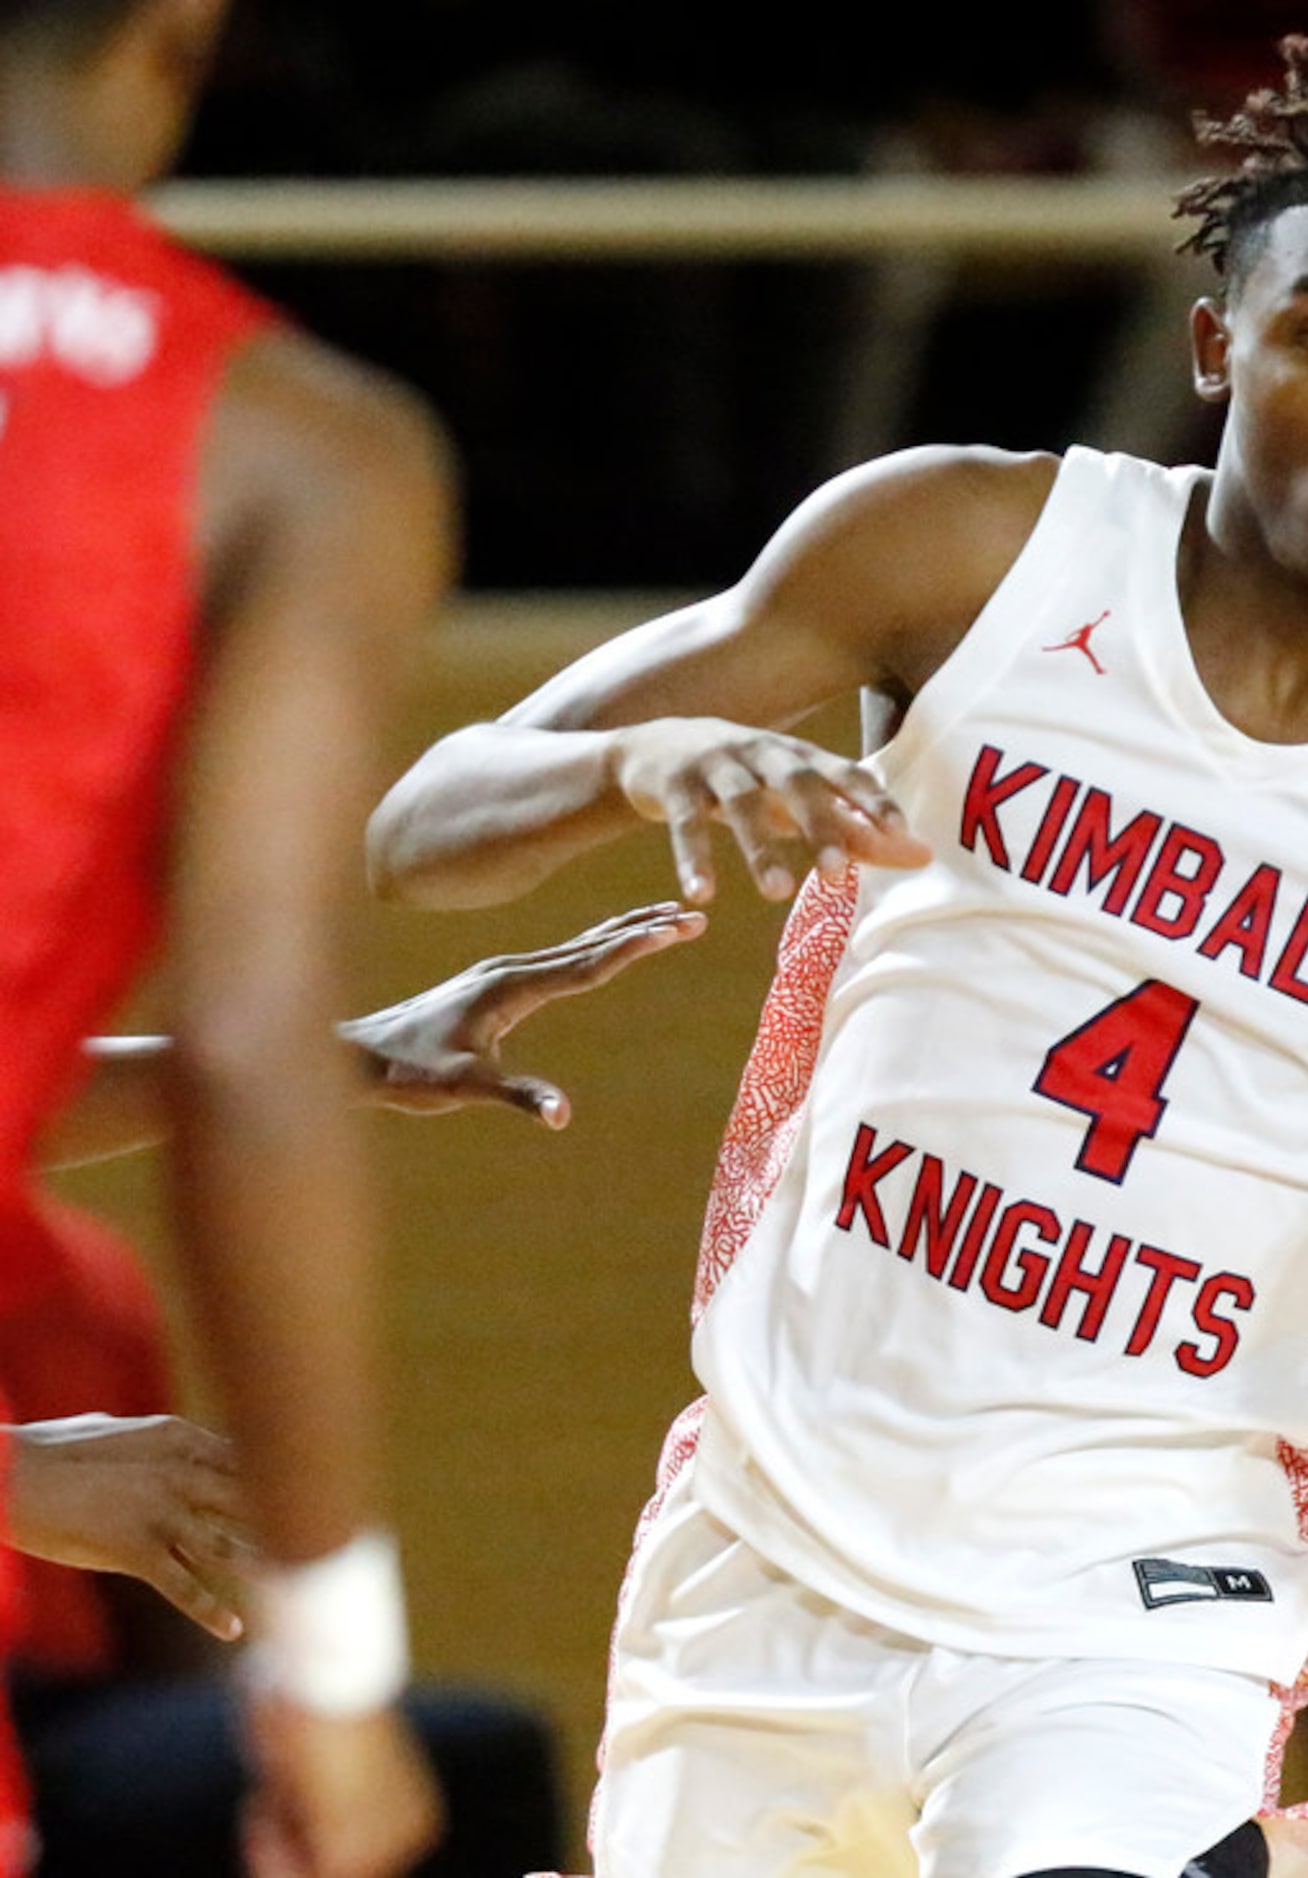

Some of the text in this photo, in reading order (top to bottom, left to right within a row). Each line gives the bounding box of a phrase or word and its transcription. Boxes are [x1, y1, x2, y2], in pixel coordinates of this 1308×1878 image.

[1032, 977, 1201, 1186] 4
[835, 1122, 1256, 1379] KNIGHTS
[1226, 1574, 1251, 1591] M
